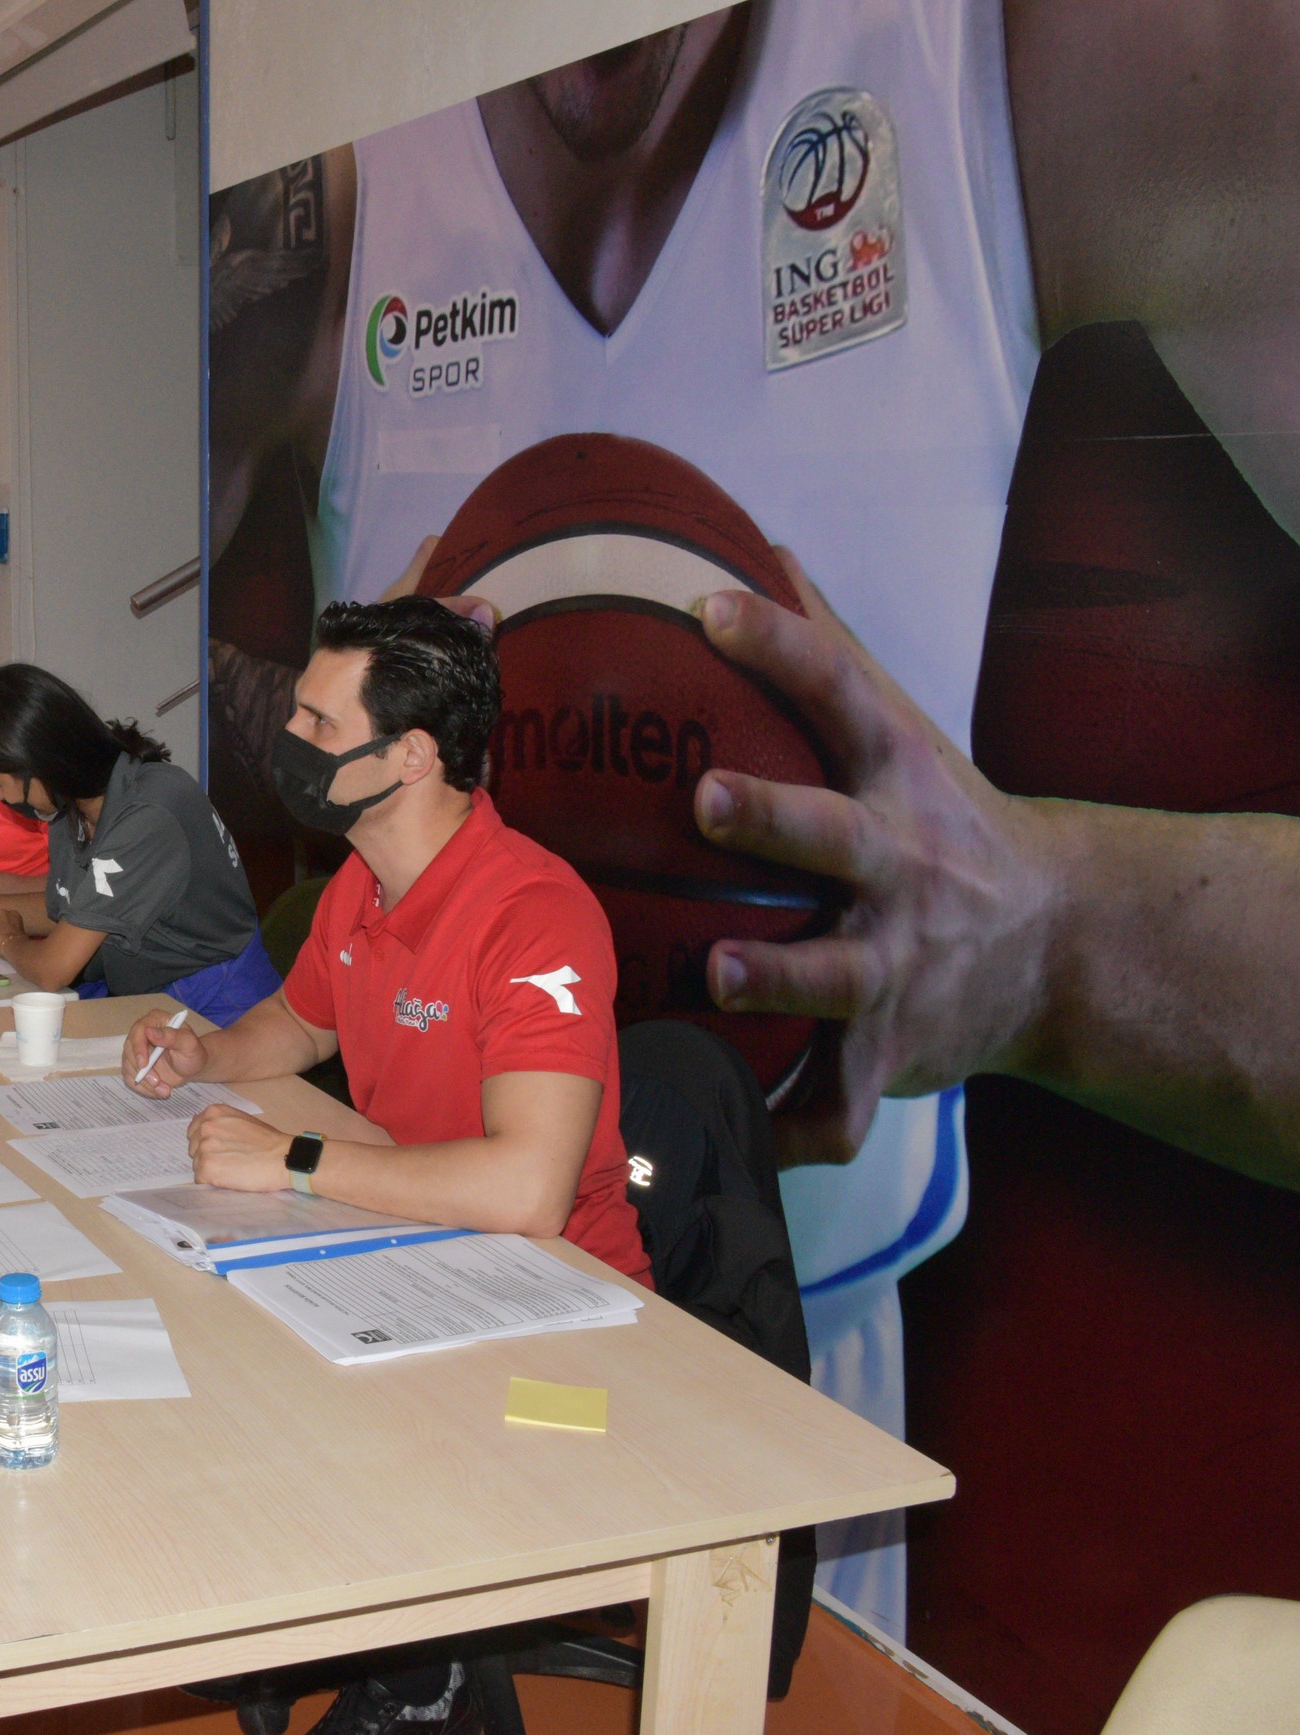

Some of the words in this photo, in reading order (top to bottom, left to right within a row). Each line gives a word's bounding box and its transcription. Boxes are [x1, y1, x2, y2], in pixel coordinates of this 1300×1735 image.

[773, 249, 839, 299] ING
[773, 263, 894, 325] BASKETBOL
[414, 291, 517, 350] Petkim
[412, 356, 480, 393] SPOR
[491, 693, 713, 788] molten
